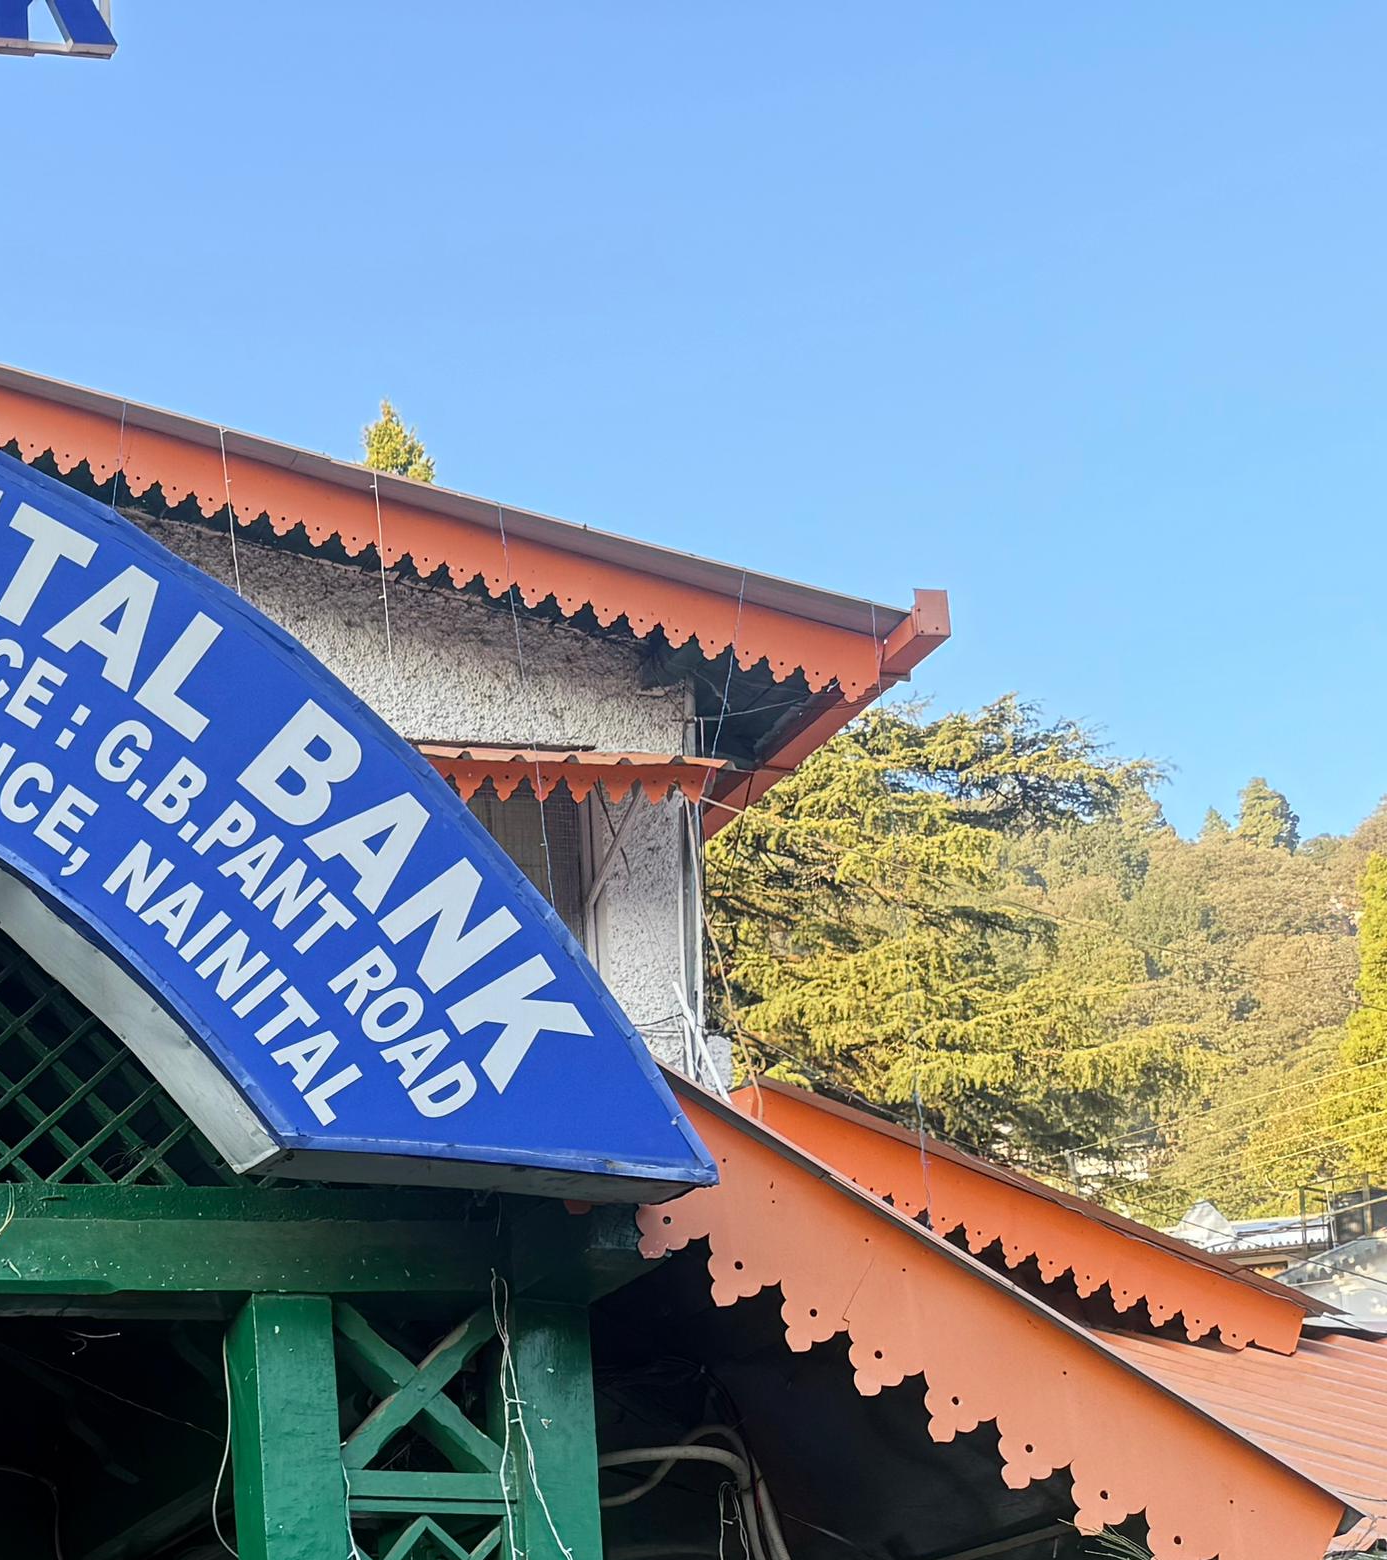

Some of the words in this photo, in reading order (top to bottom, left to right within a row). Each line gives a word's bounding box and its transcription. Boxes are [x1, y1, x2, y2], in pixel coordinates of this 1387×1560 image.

[103, 839, 363, 1127] NAINITAL
[237, 699, 595, 1095] BANK
[328, 945, 478, 1118] ROAD
